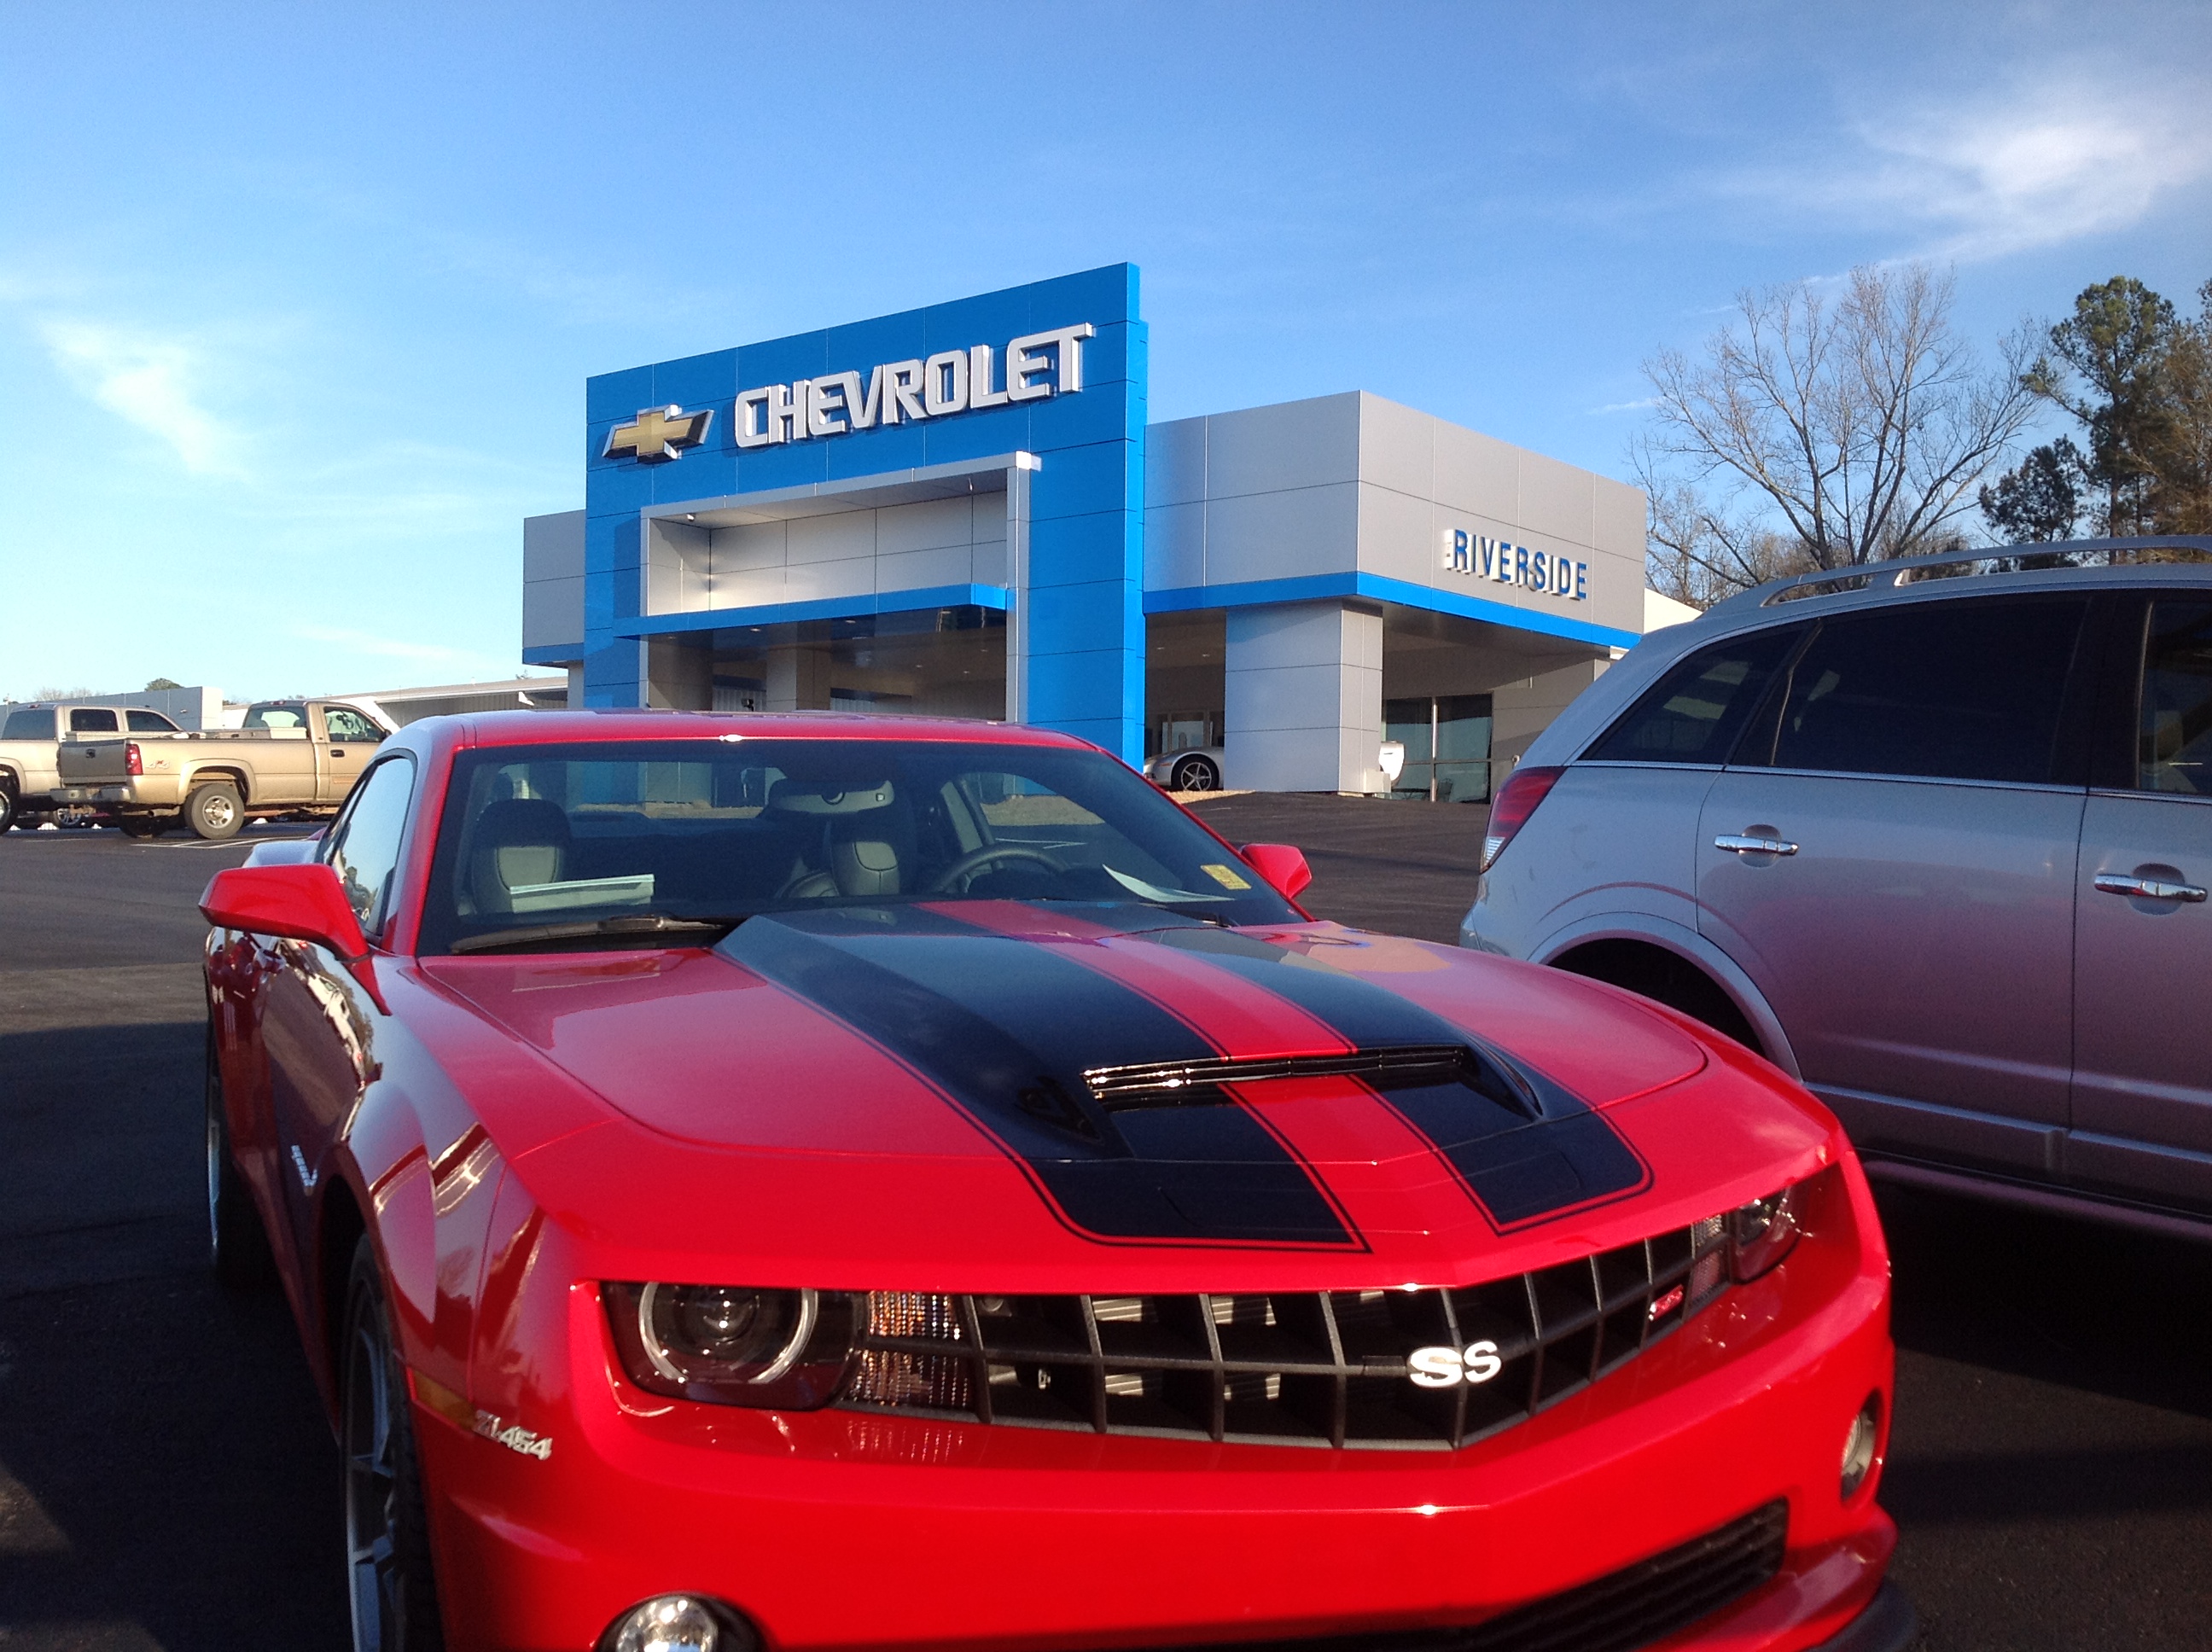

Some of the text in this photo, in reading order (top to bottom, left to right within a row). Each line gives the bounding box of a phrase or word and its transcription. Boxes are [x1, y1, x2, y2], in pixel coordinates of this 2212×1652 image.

[735, 323, 1094, 448] CHEVROLET
[1449, 528, 1586, 600] RIVERSIDE
[1409, 1341, 1502, 1387] SS
